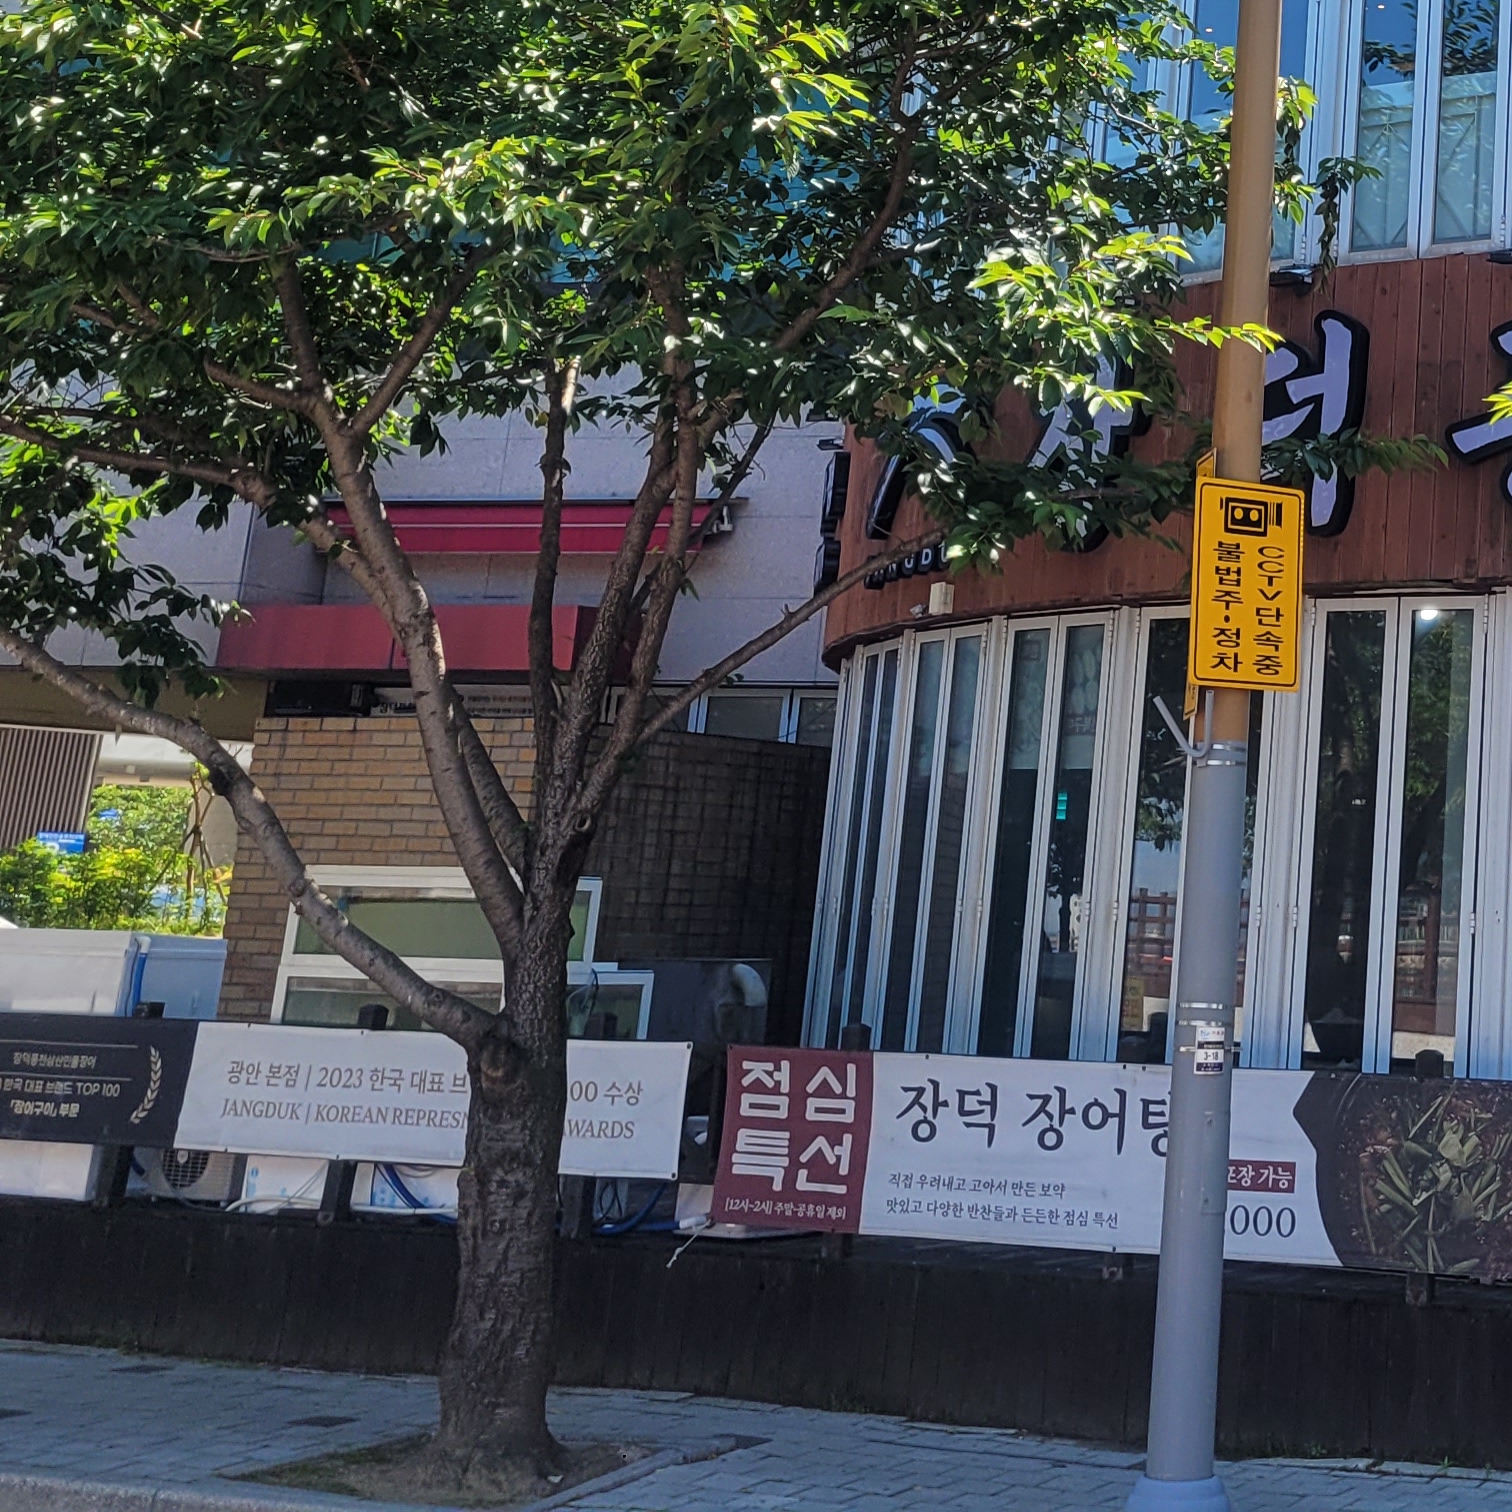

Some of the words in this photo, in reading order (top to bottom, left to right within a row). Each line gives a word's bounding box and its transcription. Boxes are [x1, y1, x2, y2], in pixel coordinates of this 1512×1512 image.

[24, 1079, 45, 1094] 대표
[45, 1081, 74, 1095] 브랜드
[75, 1082, 101, 1096] TOP
[101, 1083, 121, 1097] 100
[227, 1060, 262, 1087] 광안
[265, 1062, 301, 1089] 본점
[316, 1066, 364, 1089] 2023
[369, 1067, 405, 1094] 한국
[410, 1069, 445, 1095] 대표
[569, 1080, 598, 1103] 00
[603, 1080, 644, 1107] 수상
[741, 1059, 857, 1124] 점심
[59, 1102, 80, 1118] 부문
[220, 1097, 303, 1121] JANGDUK
[314, 1103, 390, 1125] KOREAN
[391, 1107, 468, 1131] REPRESN
[564, 1119, 636, 1140] WARDS
[895, 1078, 999, 1149] 장덕
[731, 1128, 853, 1195] 특선
[1257, 1165, 1293, 1189] 가능
[888, 1172, 915, 1190] 직접
[916, 1173, 967, 1192] 우려내고
[969, 1178, 1008, 1197] 고아서
[1011, 1180, 1037, 1199] 만든
[1038, 1181, 1066, 1199] 보약
[826, 1205, 847, 1220] 제외
[886, 1198, 924, 1216] 맛있고
[926, 1199, 965, 1220] 다양한
[967, 1203, 1019, 1223] 반찬들과
[1021, 1207, 1061, 1226] 든든한
[1063, 1209, 1090, 1227] 점심
[1092, 1211, 1119, 1230] 특선
[1229, 1204, 1296, 1238] 000
